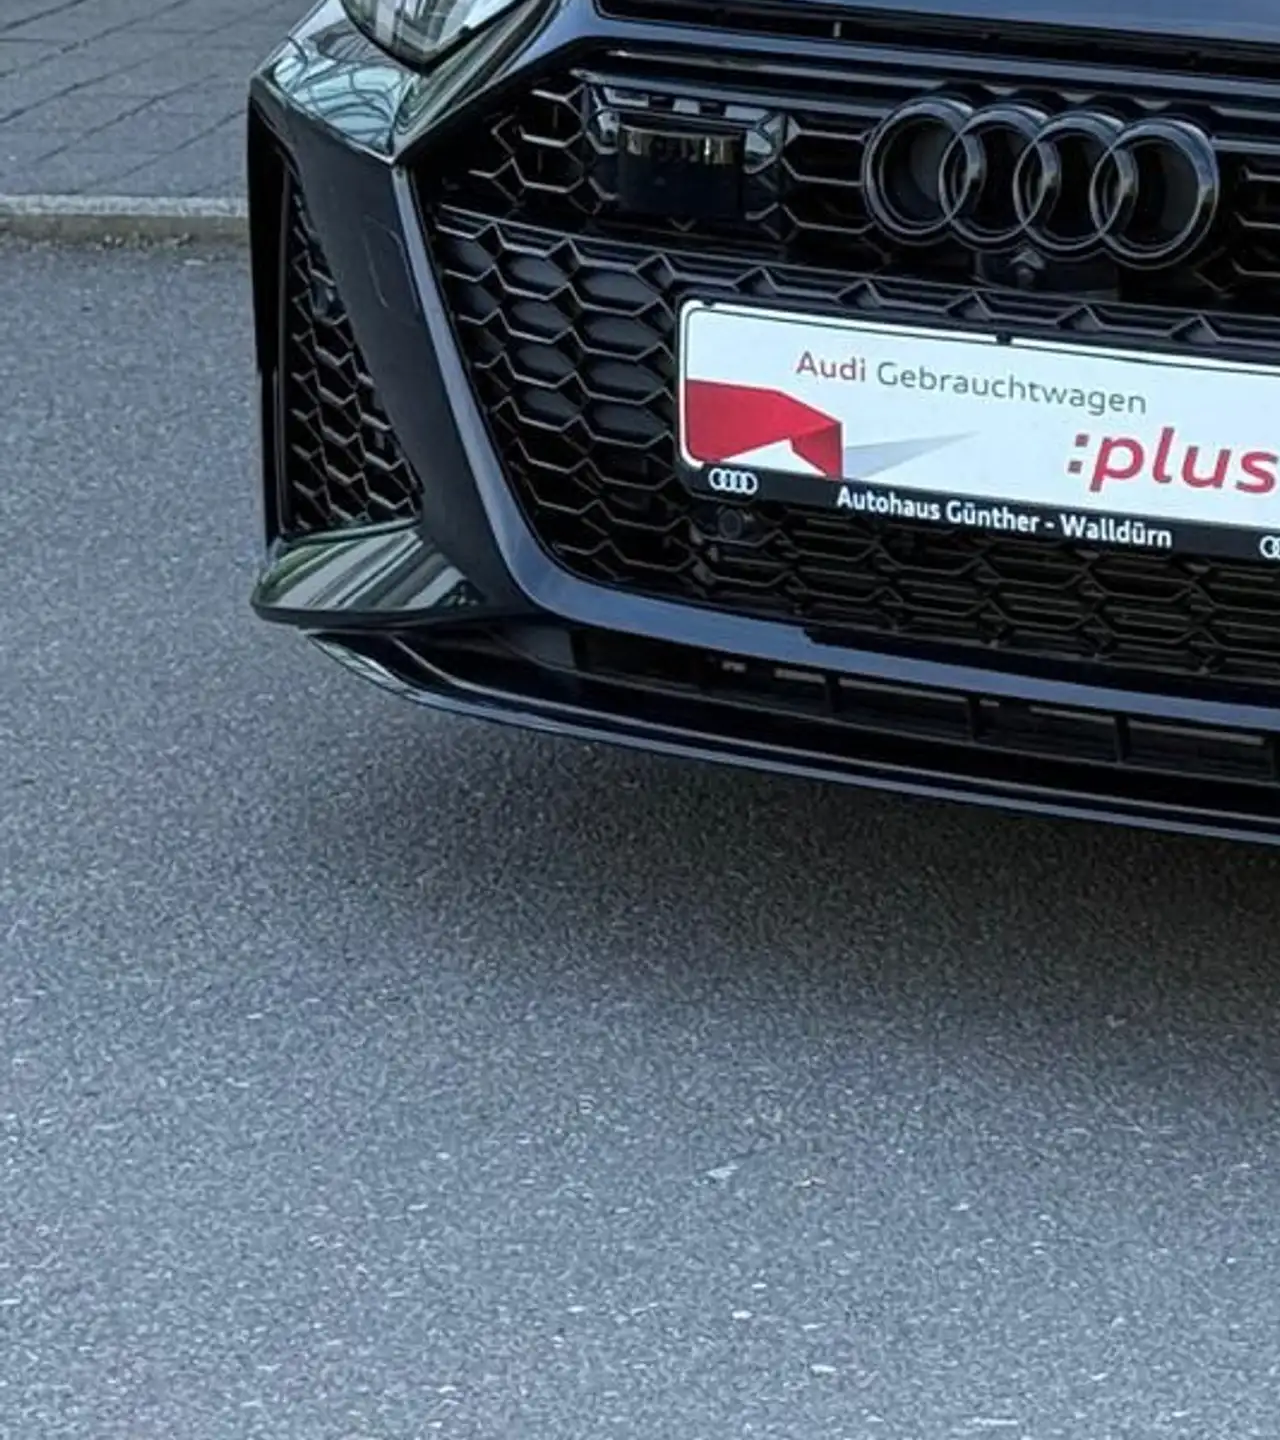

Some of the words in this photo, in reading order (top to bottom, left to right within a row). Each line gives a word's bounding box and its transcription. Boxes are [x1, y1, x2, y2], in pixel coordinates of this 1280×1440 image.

[795, 350, 867, 383] Audi
[876, 361, 1147, 417] Gebrauchtwagen
[836, 485, 941, 520] Autohaus
[945, 499, 1039, 534] Günther
[1060, 513, 1173, 549] Walldürn
